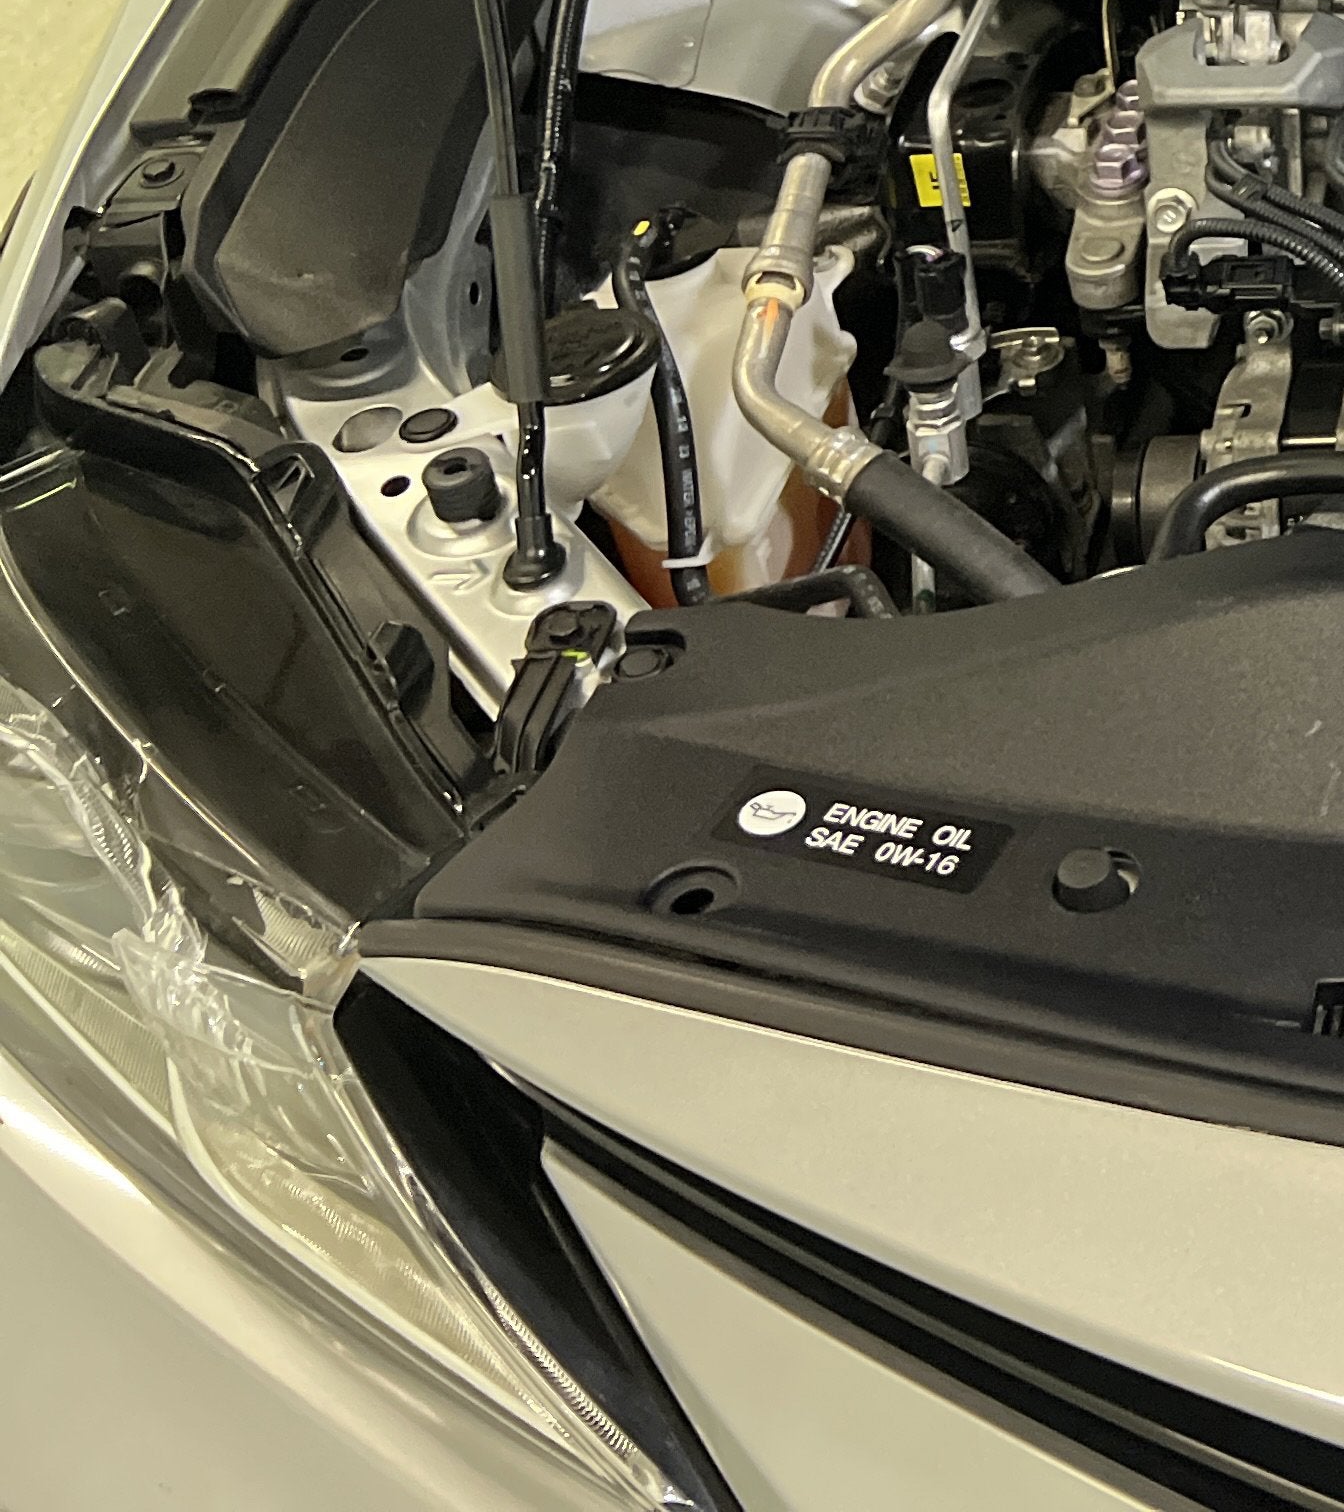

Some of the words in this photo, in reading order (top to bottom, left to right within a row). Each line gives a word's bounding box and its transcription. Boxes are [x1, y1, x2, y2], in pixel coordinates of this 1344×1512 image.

[805, 826, 865, 855] SAE
[874, 841, 960, 876] 0W-16
[823, 802, 924, 839] ENGINE
[932, 825, 972, 851] OIL
